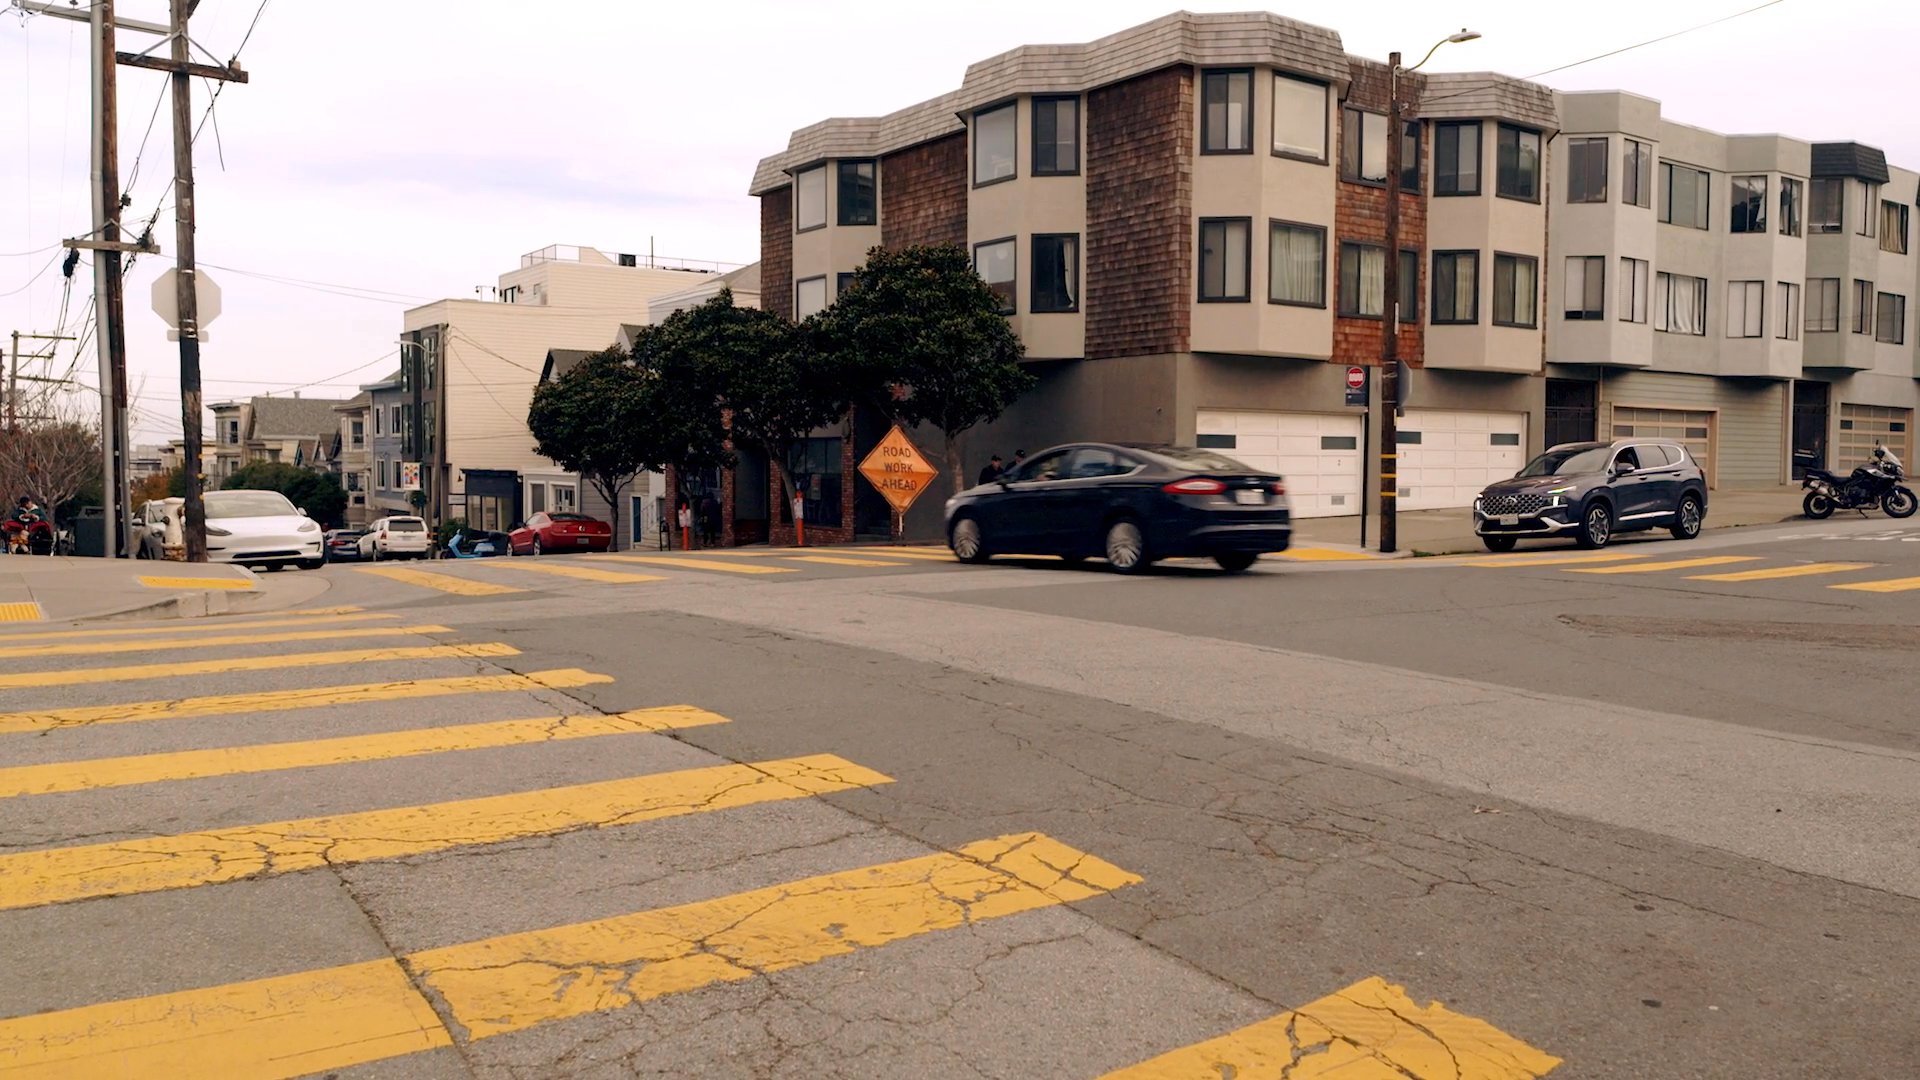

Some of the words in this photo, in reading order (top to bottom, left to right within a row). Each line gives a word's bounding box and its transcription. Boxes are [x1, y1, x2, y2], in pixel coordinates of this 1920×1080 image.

[883, 447, 911, 458] ROAD
[884, 462, 913, 474] WORK
[881, 479, 917, 491] AHEAD
